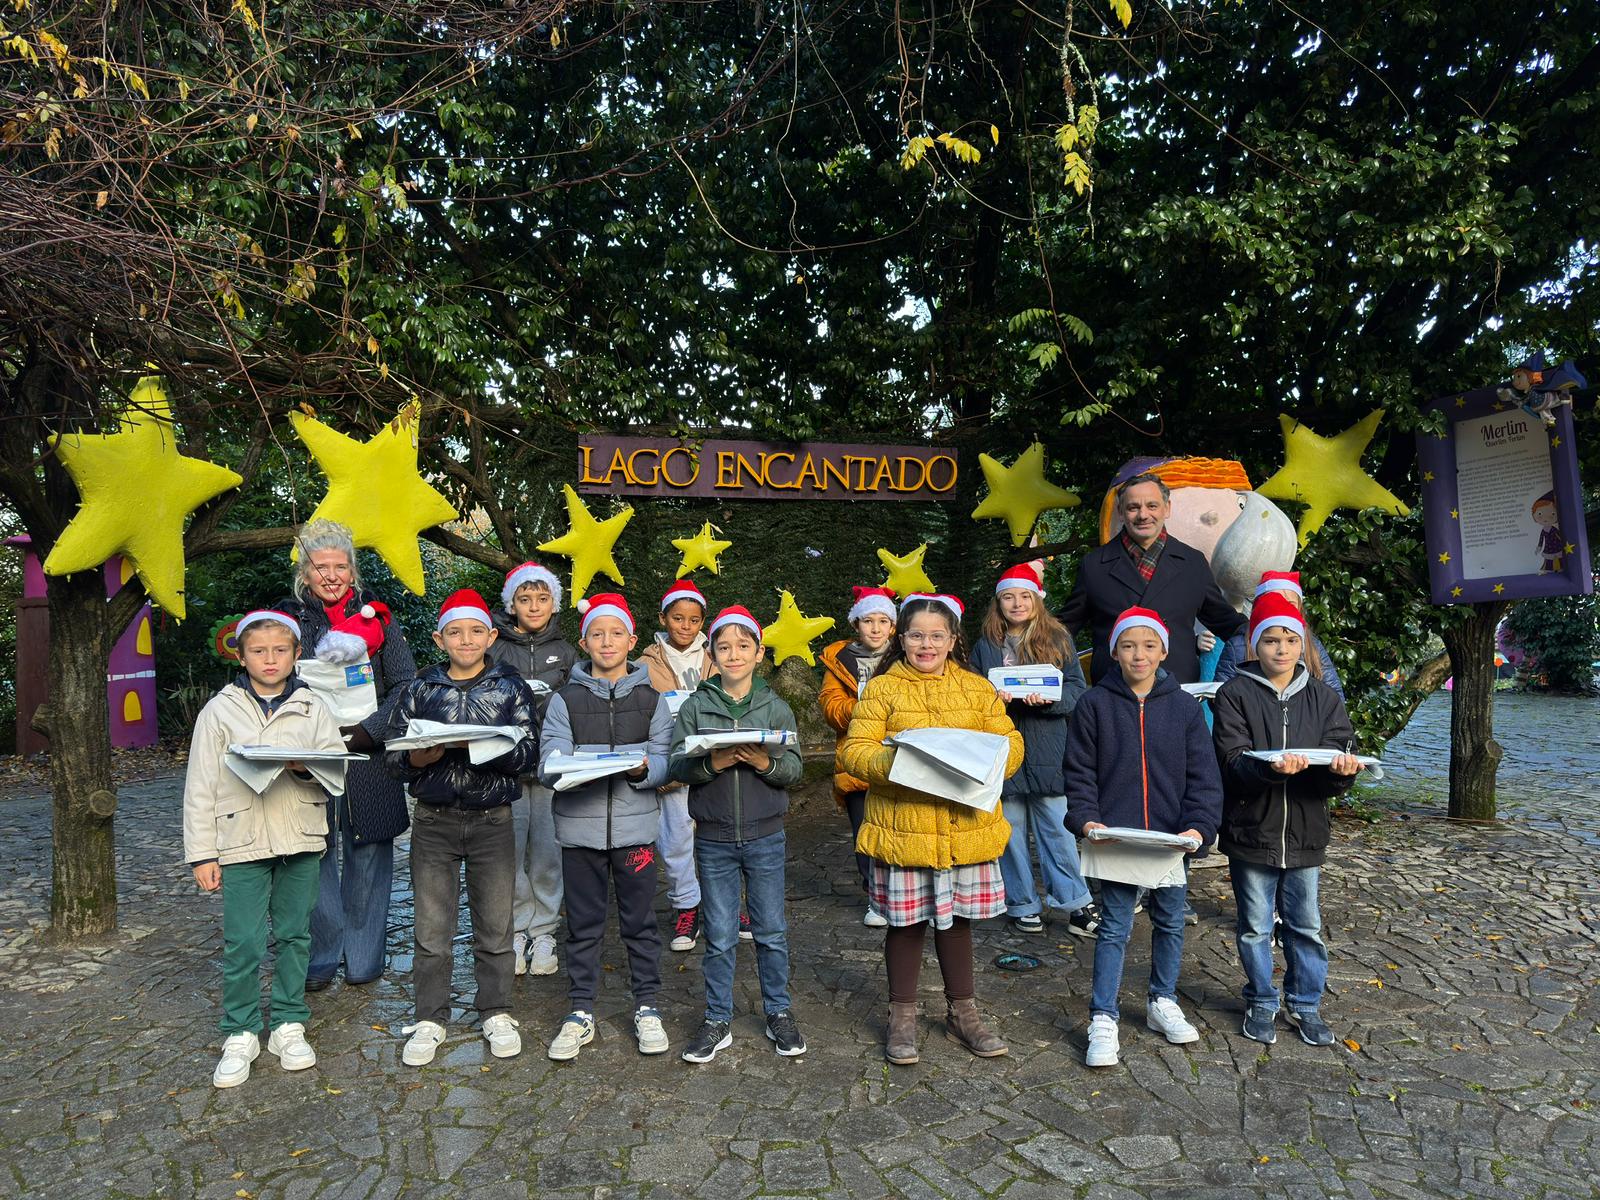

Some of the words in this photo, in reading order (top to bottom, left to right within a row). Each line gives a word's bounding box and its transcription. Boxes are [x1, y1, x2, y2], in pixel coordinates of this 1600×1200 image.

[1481, 420, 1528, 441] Merlim
[578, 446, 700, 487] LAGO
[715, 451, 959, 493] ENCANTADO
